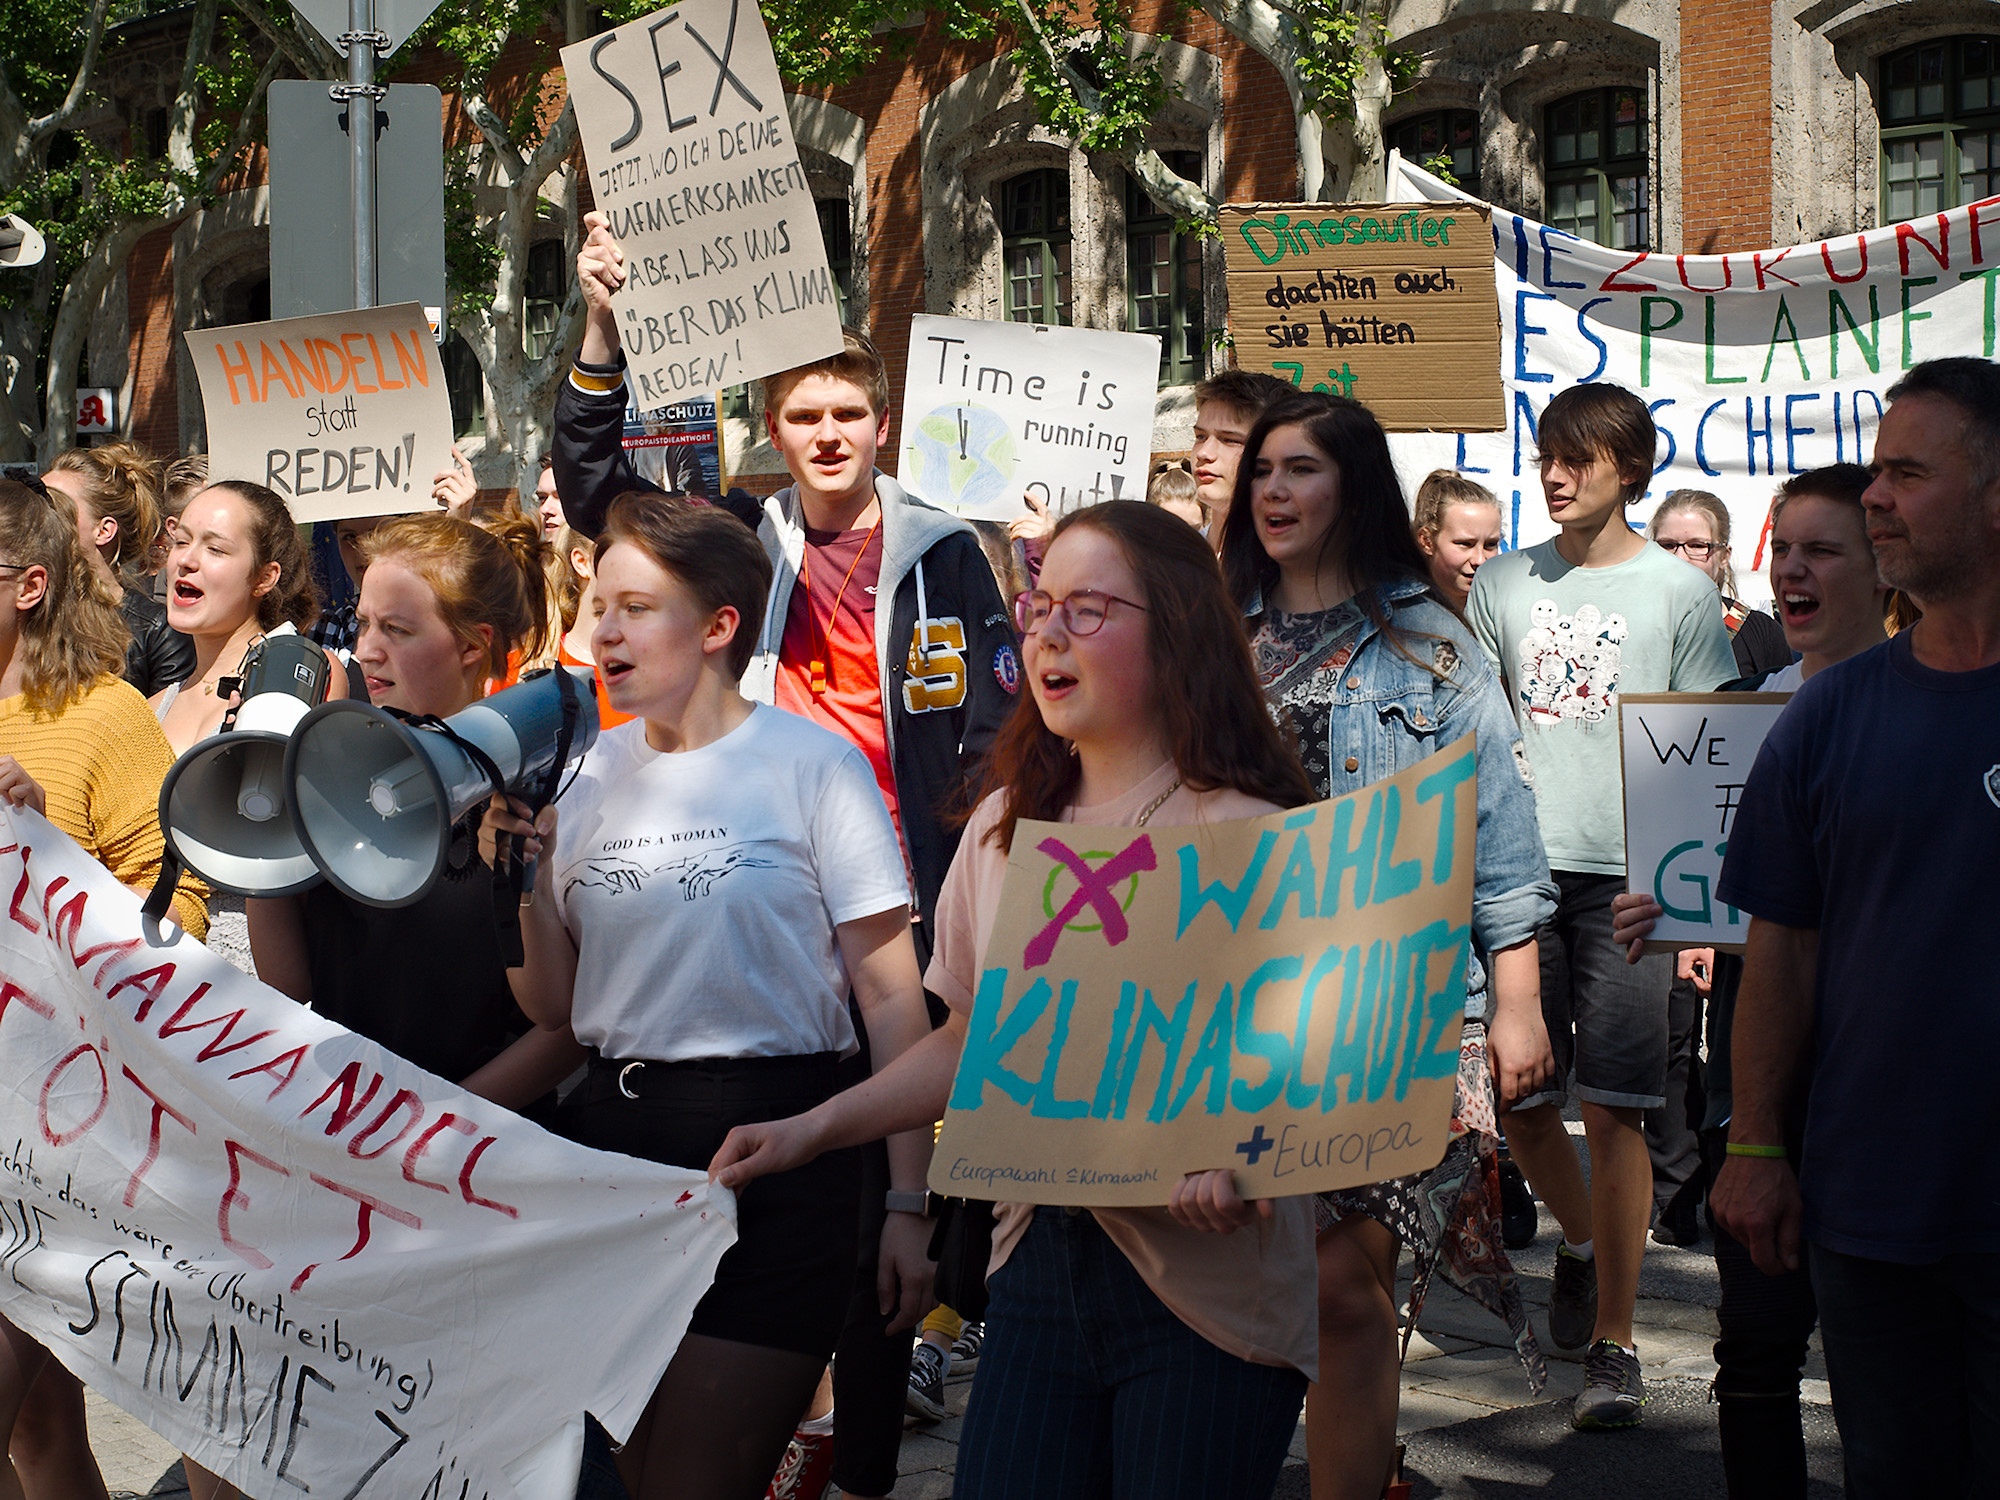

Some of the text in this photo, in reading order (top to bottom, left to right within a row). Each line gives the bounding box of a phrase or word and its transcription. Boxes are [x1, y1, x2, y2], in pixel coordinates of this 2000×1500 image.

[590, 0, 763, 153] SEX
[599, 115, 783, 197] JETZT, WO ICH DEINE
[628, 219, 791, 293] ABE, LASS UNS
[1239, 210, 1456, 265] Dinosaurier
[1493, 215, 1586, 290] IE
[625, 266, 834, 356] ÜBER DAS KLIMA
[1265, 268, 1377, 310] dachten
[1265, 309, 1416, 348] sie hätten
[1501, 290, 1612, 384] ES
[215, 328, 429, 405] HANDELN
[639, 338, 743, 401] REDEN!
[927, 336, 1117, 411] Time is
[306, 395, 357, 437] statt
[623, 404, 713, 423] LIMASCHUTZ
[1023, 419, 1128, 465] running
[266, 432, 415, 496] REDEN!
[1638, 716, 1730, 766] WE
[602, 827, 728, 853] GOD IS A WOMAN
[1175, 749, 1476, 942] WÄHLT
[0, 843, 519, 1220] LIMAWANDEL
[948, 919, 1473, 1124] KLIMASCHUTZ
[950, 1158, 1057, 1187] Europawahl
